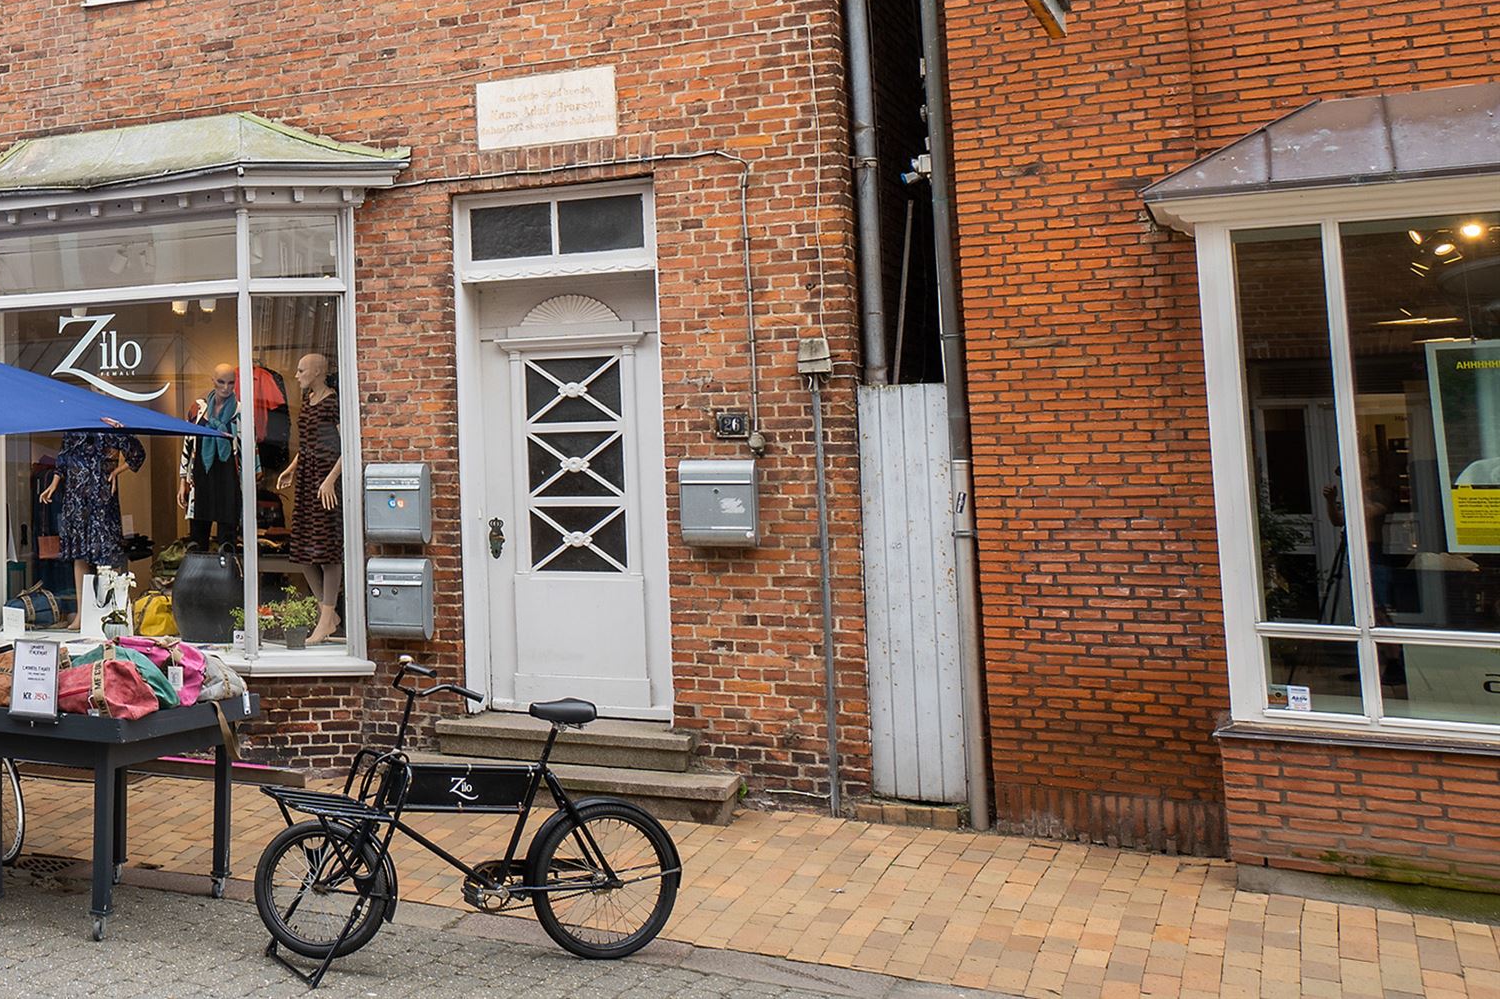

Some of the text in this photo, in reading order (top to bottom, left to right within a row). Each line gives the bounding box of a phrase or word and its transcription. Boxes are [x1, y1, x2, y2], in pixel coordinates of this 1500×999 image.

[51, 313, 171, 402] Zilo
[724, 418, 740, 432] 26
[449, 777, 479, 800] Zilo
